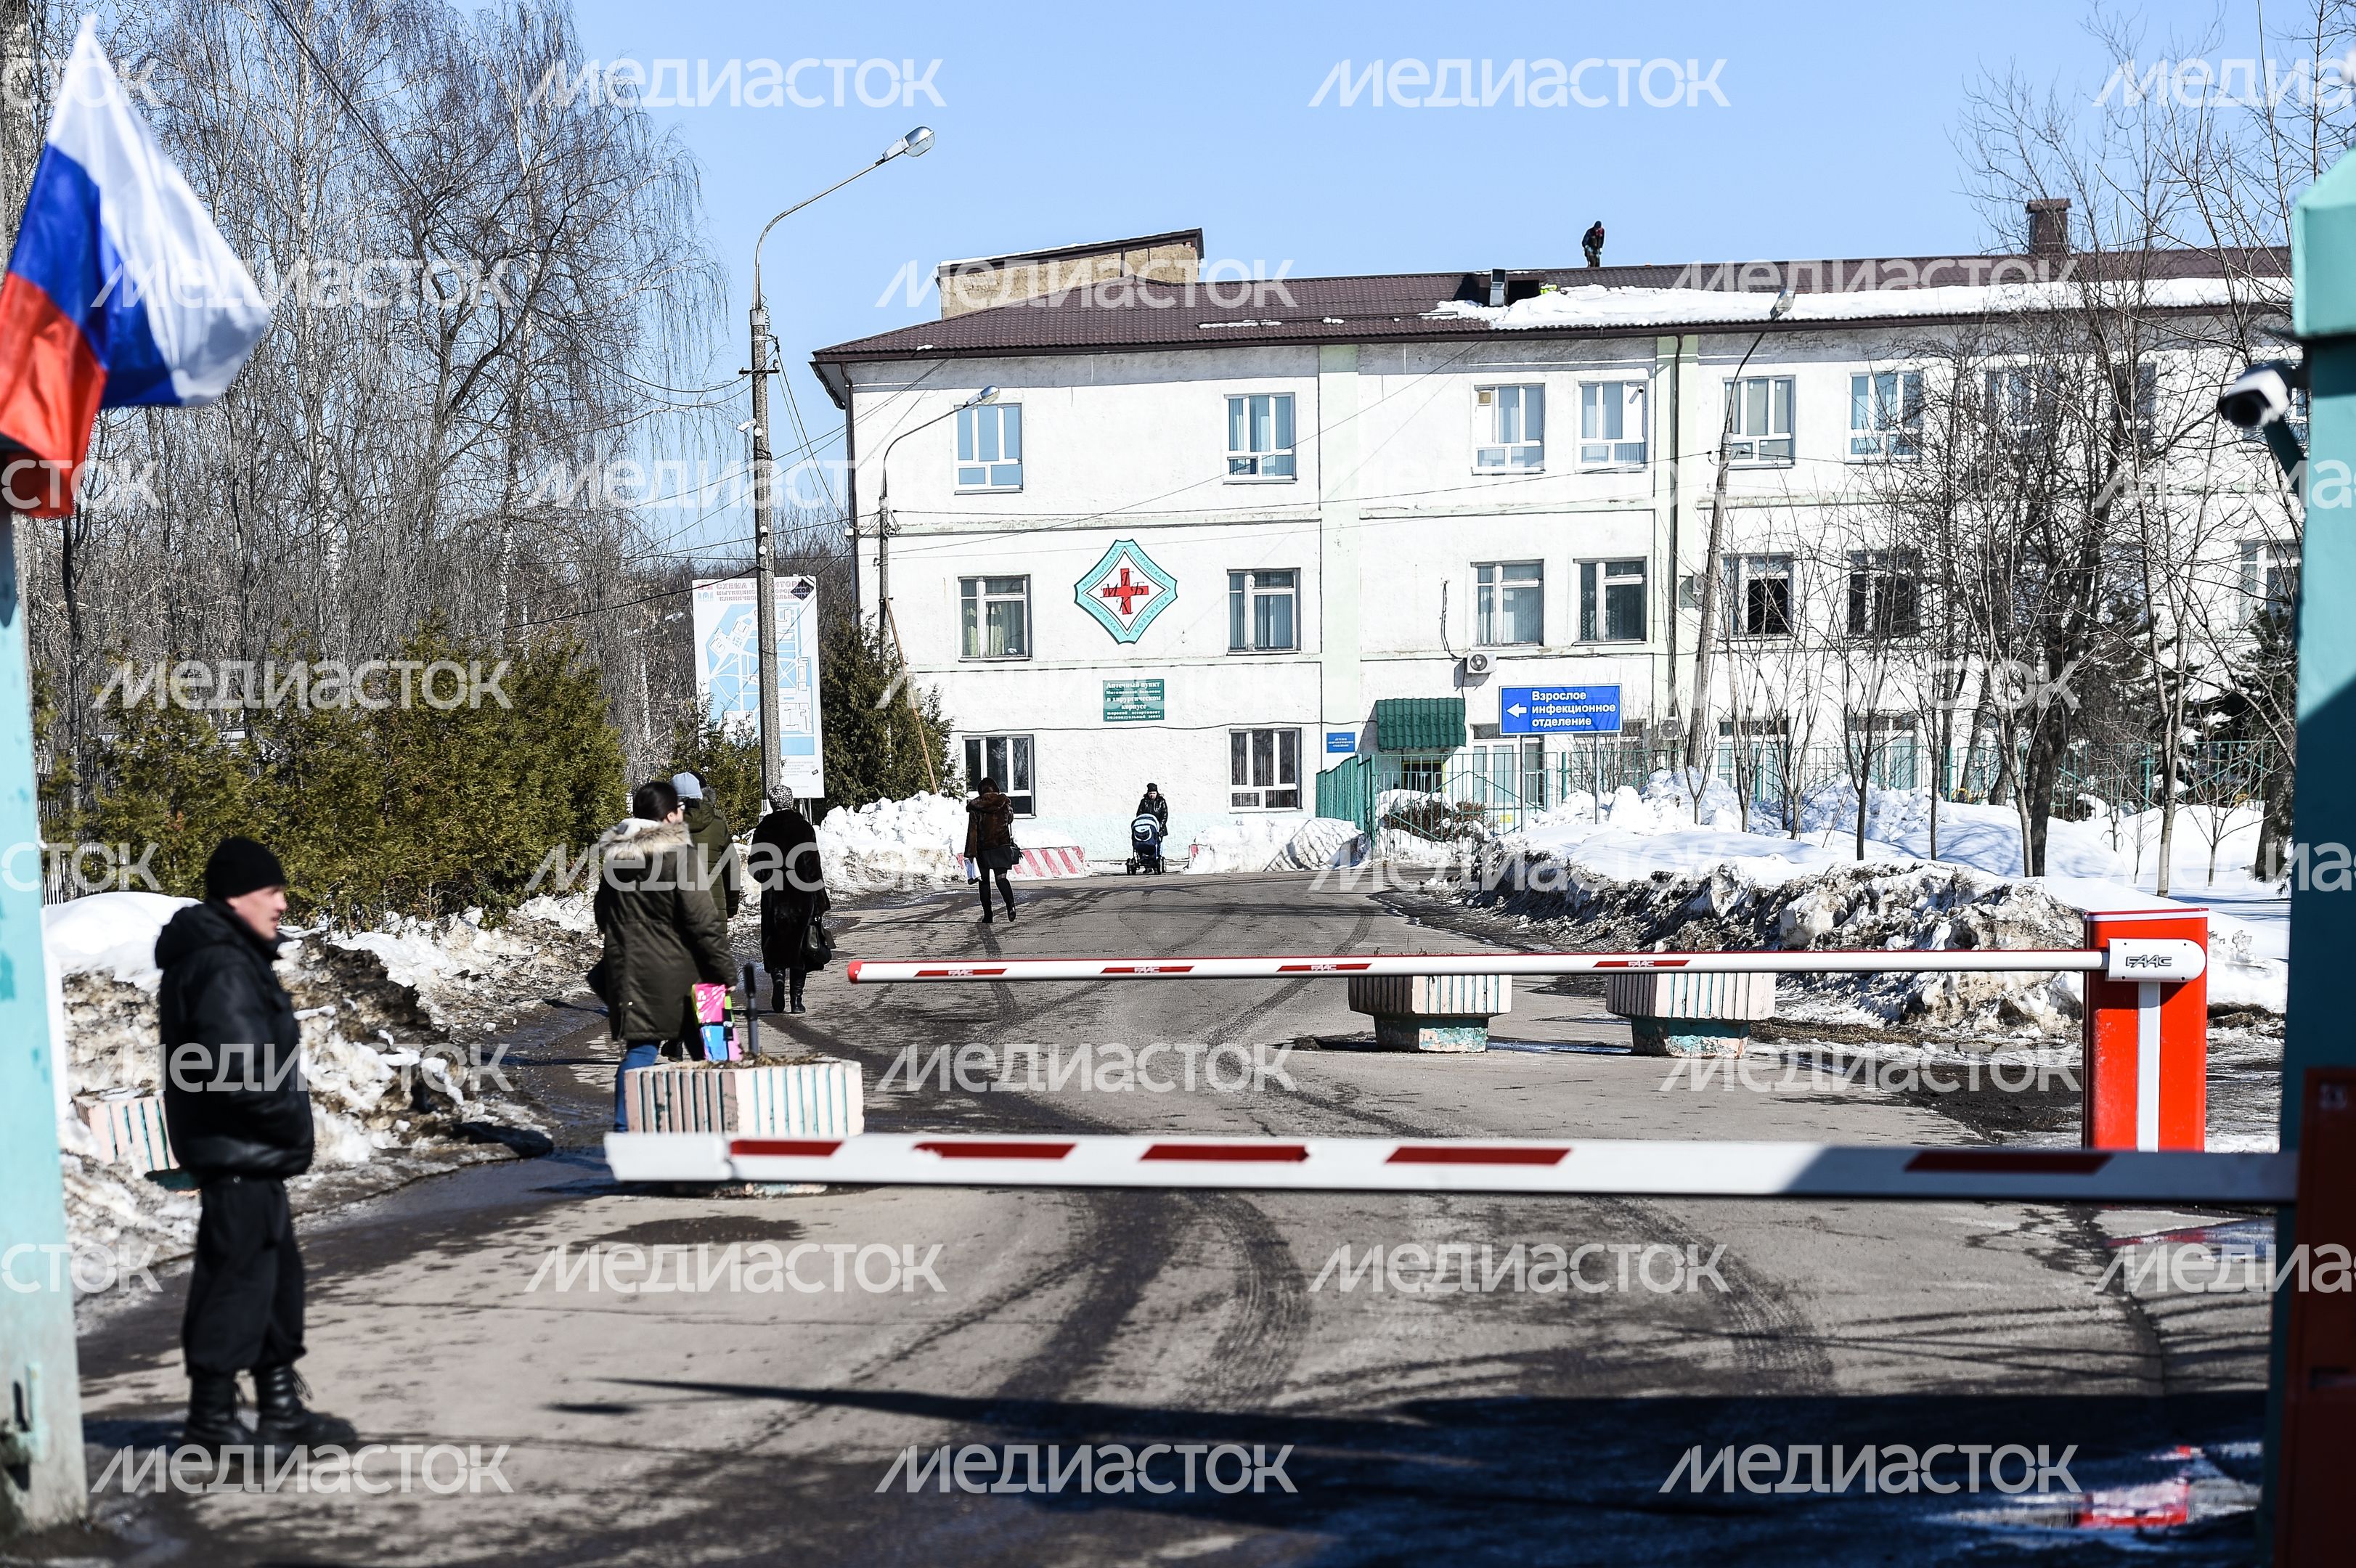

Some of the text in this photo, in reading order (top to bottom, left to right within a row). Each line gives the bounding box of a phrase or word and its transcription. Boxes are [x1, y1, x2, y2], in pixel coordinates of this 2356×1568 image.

[1083, 548, 1167, 587] МЫТИЩИНСКАЯ ГОРОДСКАЯ
[1086, 596, 1169, 634] КЛИНИЧЕСКАЯ БОЛЬНИЦА
[1531, 690, 1587, 703] Взрослое
[1531, 703, 1617, 716] инфекционное
[1531, 717, 1592, 728] отделение
[2125, 954, 2172, 968] FAAC
